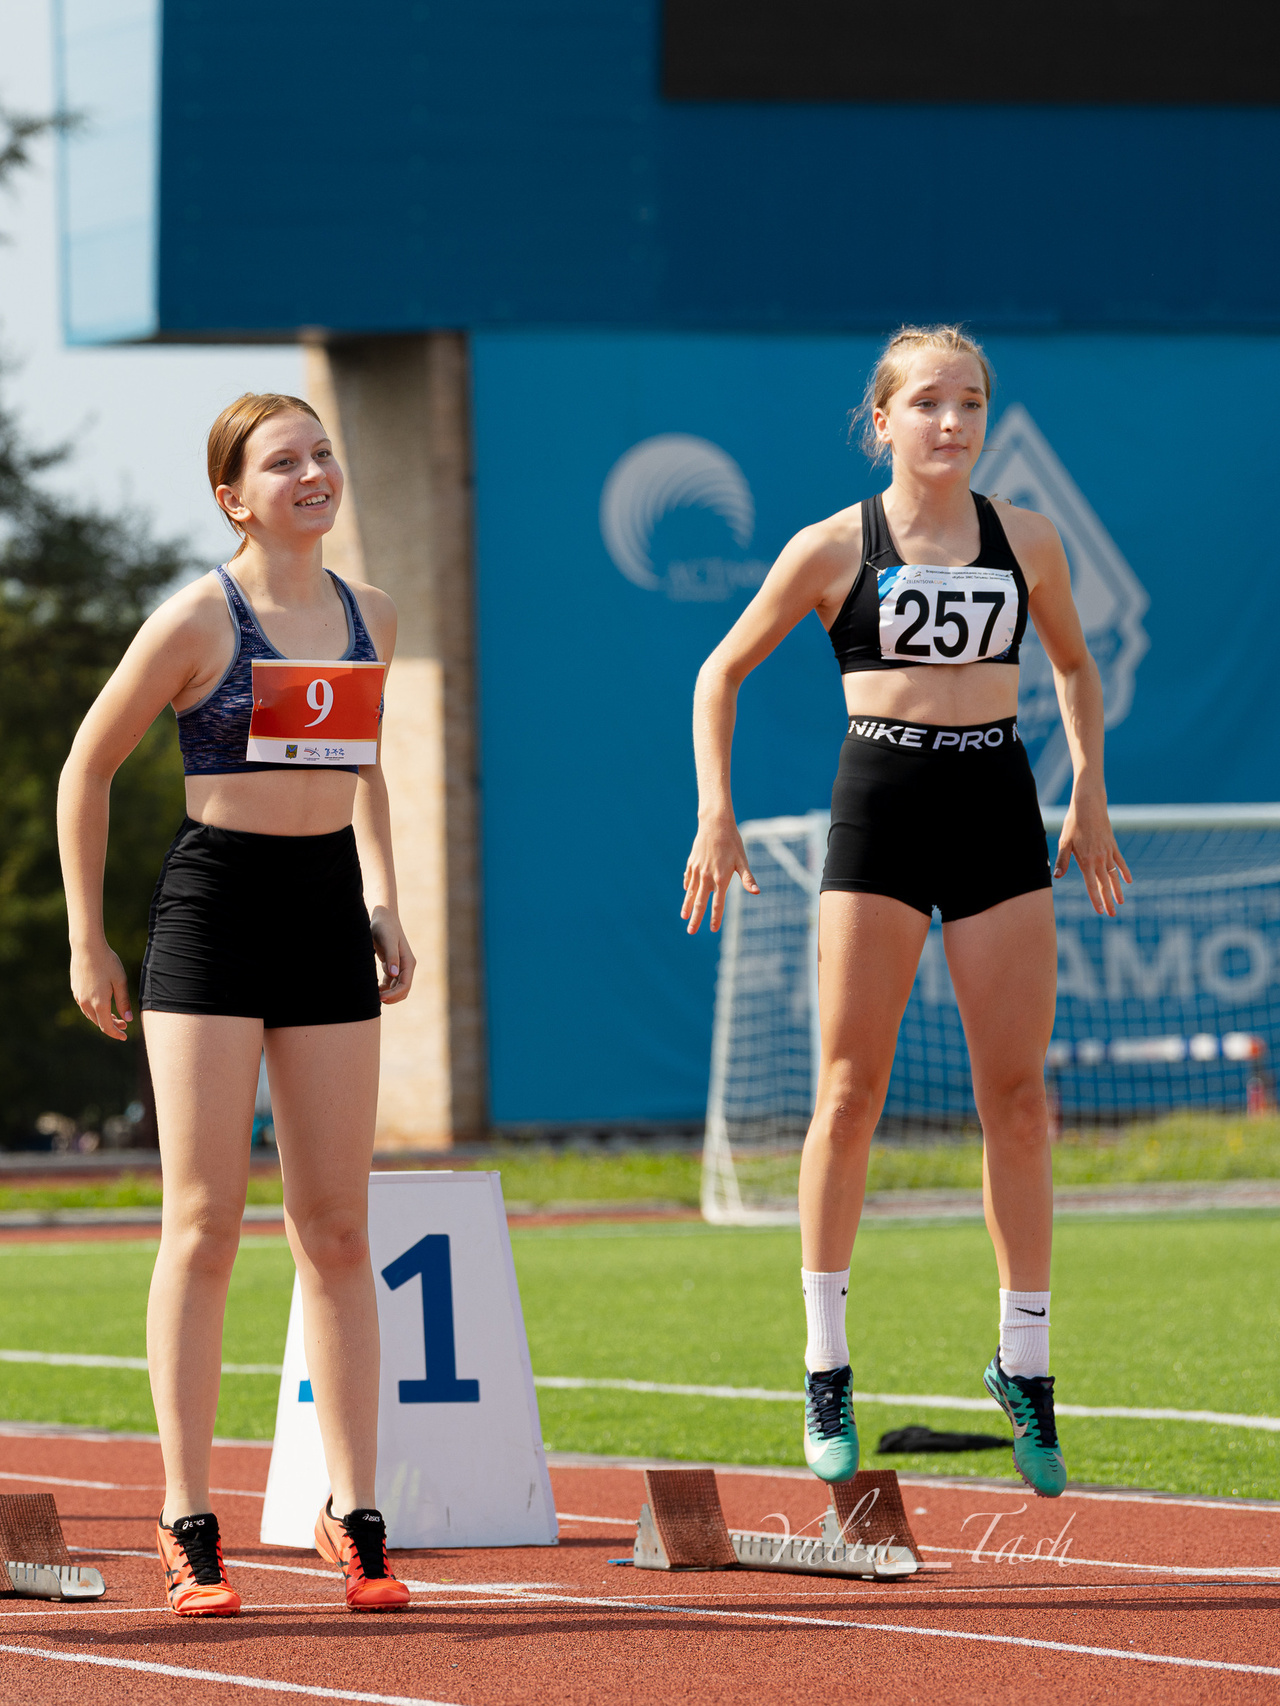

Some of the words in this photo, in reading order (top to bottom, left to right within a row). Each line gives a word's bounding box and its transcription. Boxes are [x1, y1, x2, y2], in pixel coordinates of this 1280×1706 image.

[894, 589, 1005, 658] 257
[304, 678, 334, 728] 9
[848, 720, 928, 748] NIKE
[932, 727, 1004, 752] PRO
[381, 1233, 480, 1404] 1
